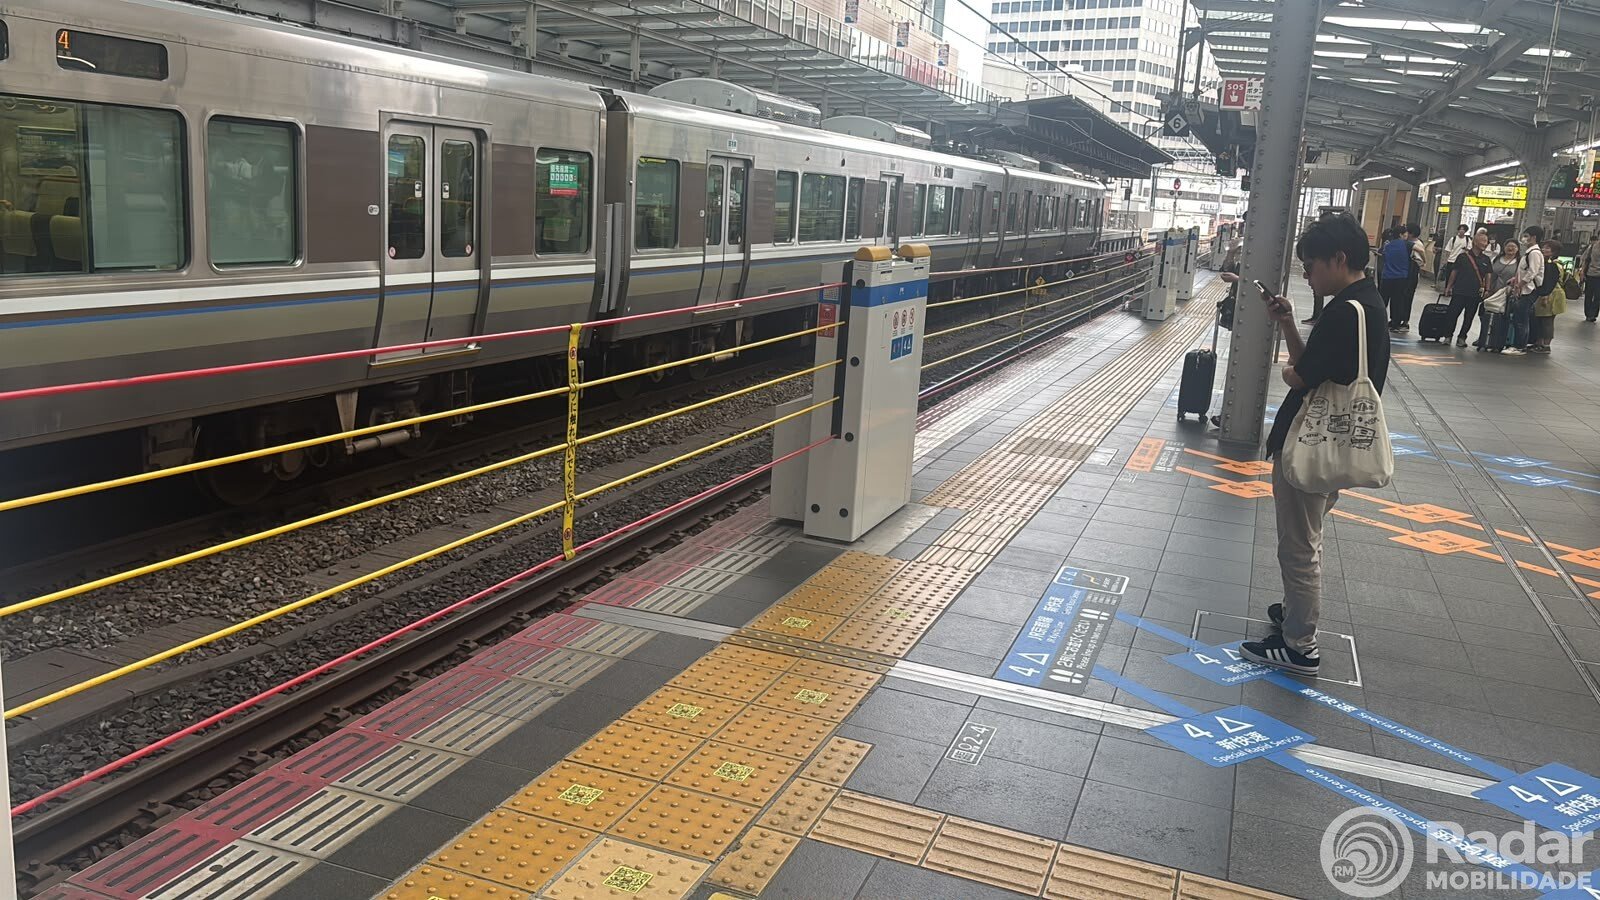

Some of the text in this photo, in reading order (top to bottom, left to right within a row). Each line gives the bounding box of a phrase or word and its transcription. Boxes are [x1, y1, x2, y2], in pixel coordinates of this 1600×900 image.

[58, 30, 70, 49] 4
[1227, 83, 1244, 91] SOS
[1173, 117, 1181, 129] 6
[1056, 619, 1092, 668] 2列にお並びください
[1195, 652, 1222, 665] 4
[1008, 664, 1041, 677] 4
[1300, 688, 1356, 713] 新快速
[958, 726, 990, 751] 02-4
[1183, 723, 1214, 738] 4
[1357, 711, 1473, 762] Special Rapid Service
[1213, 735, 1303, 762] Special Rapid Service
[1215, 731, 1270, 750] 新快速
[1305, 768, 1431, 830] Service Rapid Special
[1508, 785, 1549, 803] 4
[1561, 816, 1595, 832] Special
[1430, 829, 1511, 868] 新快速
